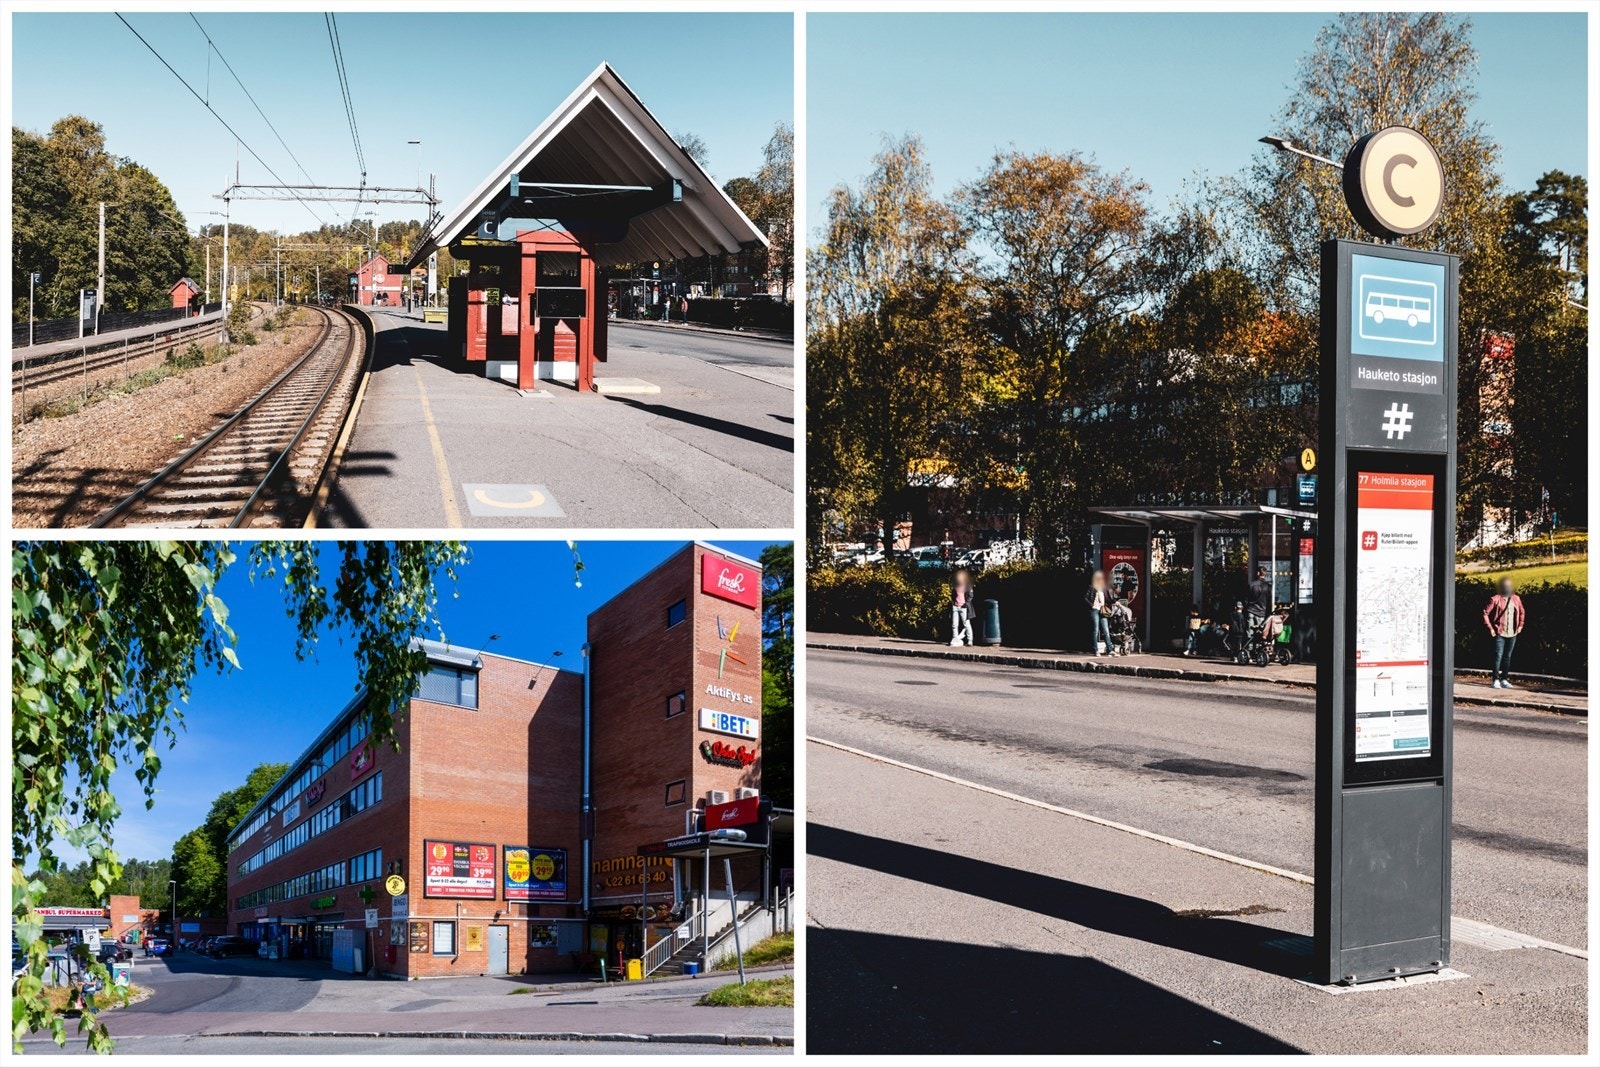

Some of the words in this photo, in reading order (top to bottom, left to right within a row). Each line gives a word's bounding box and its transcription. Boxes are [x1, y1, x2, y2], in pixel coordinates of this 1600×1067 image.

[1383, 154, 1418, 207] C
[484, 222, 493, 234] C
[1358, 367, 1400, 382] Hauketo
[1402, 372, 1437, 386] stasjon
[1306, 452, 1312, 464] A
[1358, 476, 1369, 484] 77
[1371, 476, 1398, 486] Holmlia
[1400, 478, 1427, 488] stasjon
[718, 568, 745, 592] fresh
[706, 684, 740, 702] AktiFys
[743, 694, 753, 704] as
[721, 714, 746, 734] BET
[612, 876, 624, 886] 22
[625, 874, 636, 884] 61
[653, 871, 666, 882] 40
